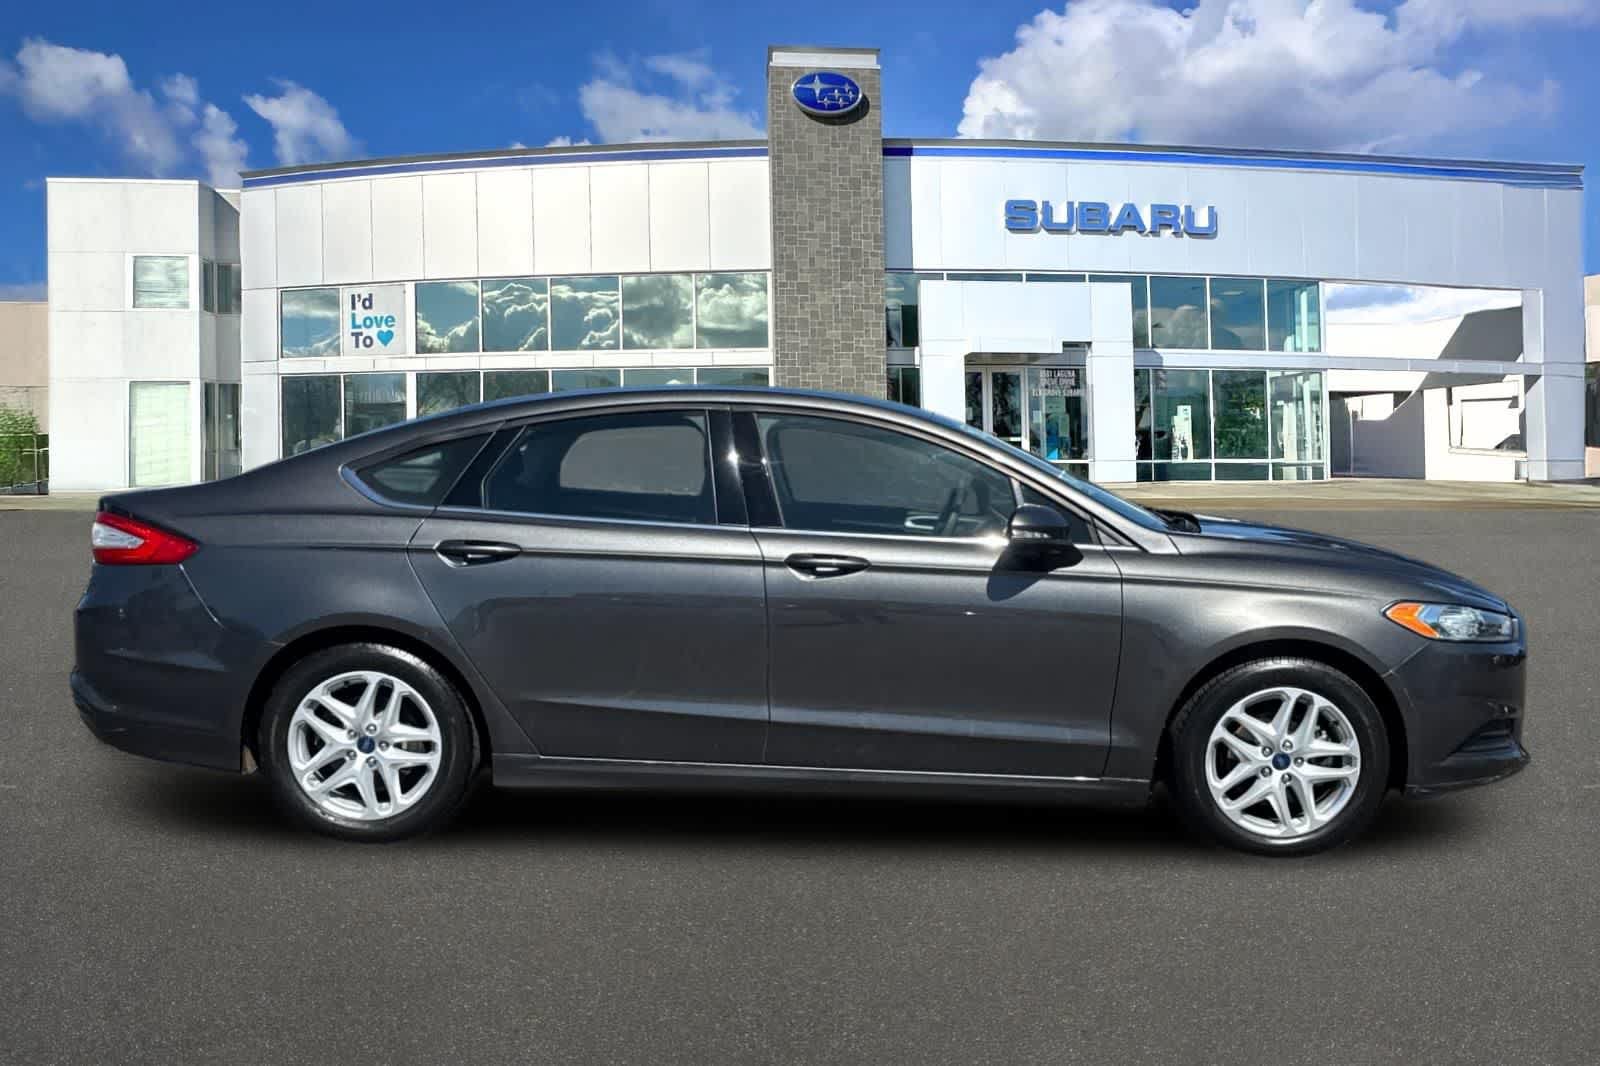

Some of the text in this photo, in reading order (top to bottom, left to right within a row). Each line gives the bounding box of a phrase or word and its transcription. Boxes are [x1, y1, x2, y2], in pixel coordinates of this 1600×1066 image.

[1004, 199, 1218, 239] SUBARU
[351, 293, 373, 310] I'd
[351, 313, 396, 329] Love
[351, 332, 374, 348] To
